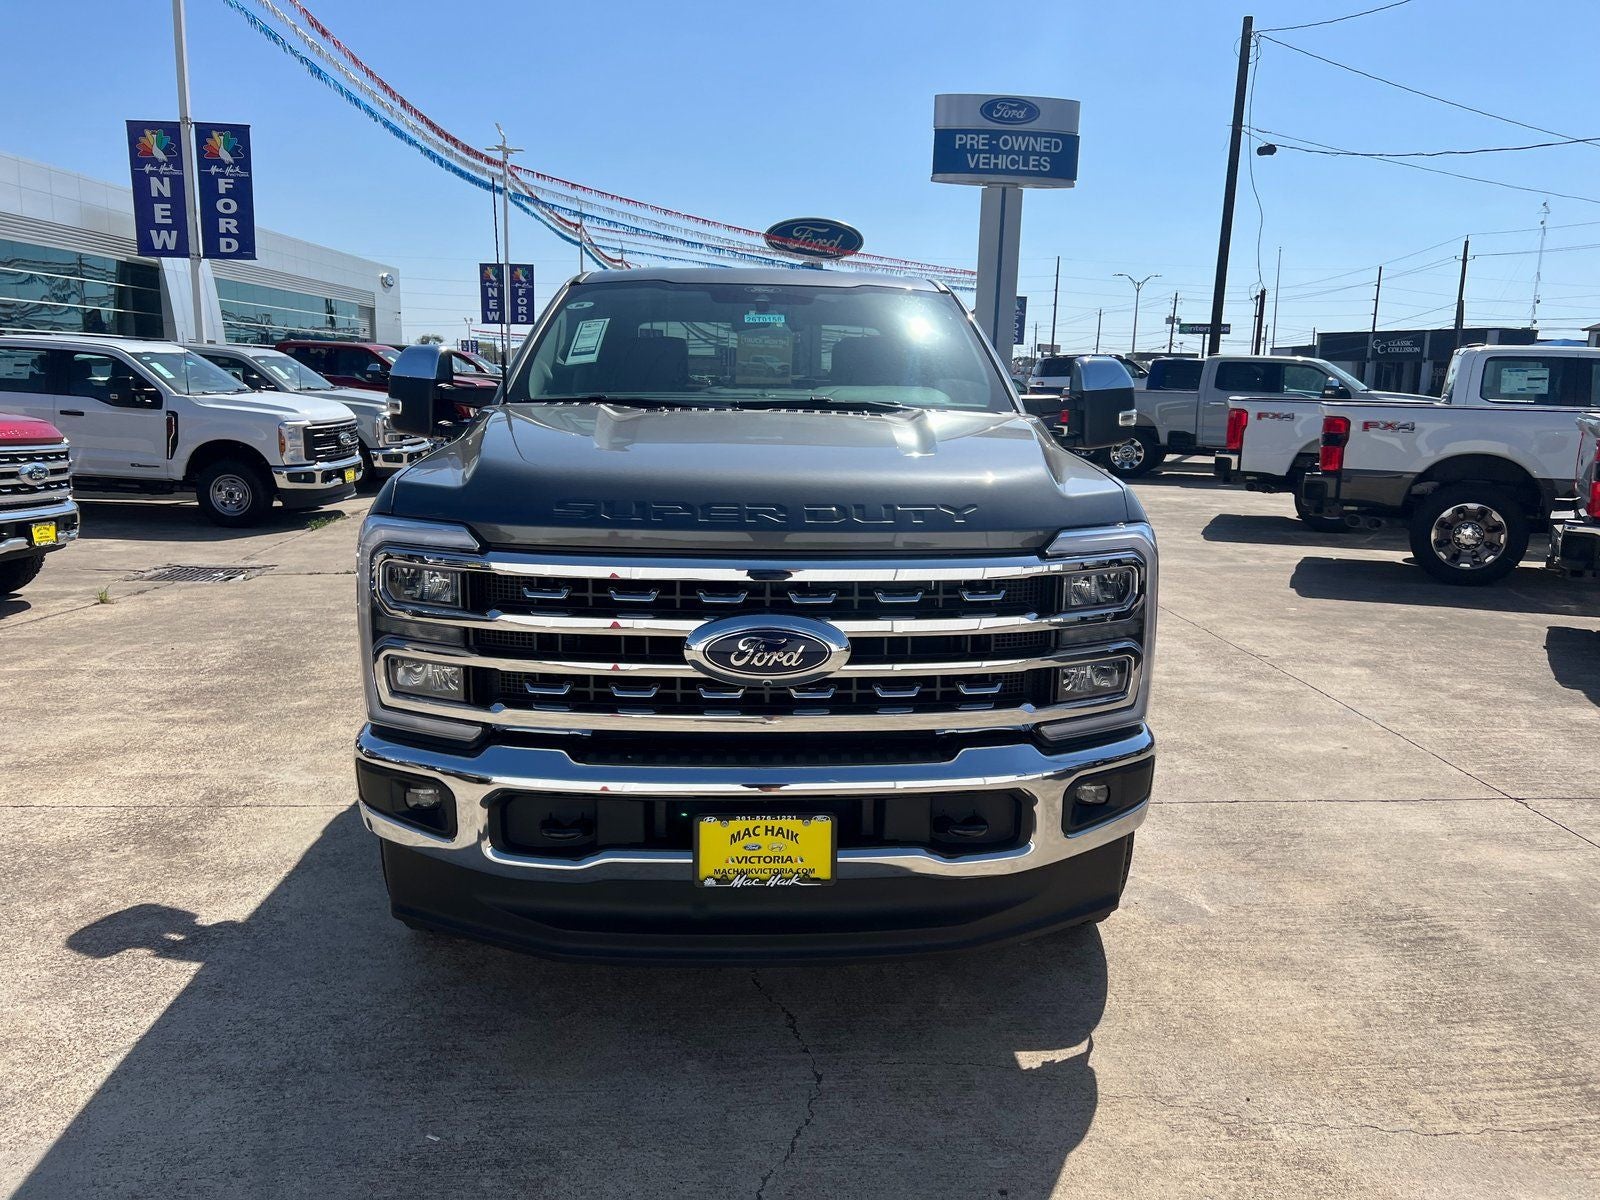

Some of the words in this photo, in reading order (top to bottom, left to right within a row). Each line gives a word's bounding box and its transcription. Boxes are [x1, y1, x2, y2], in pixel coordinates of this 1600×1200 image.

[993, 102, 1028, 119] Ford
[967, 153, 1051, 171] VEHICLES
[149, 176, 178, 251] NEW
[216, 178, 240, 253] FORD
[487, 287, 500, 321] NEW
[517, 288, 528, 322] FORD
[1256, 412, 1295, 421] FX4
[1361, 421, 1415, 433] FX4
[552, 502, 788, 523] SUPER
[803, 503, 978, 524] DUTY
[730, 636, 805, 667] Ford
[729, 826, 761, 846] MAC
[764, 825, 800, 845] HAIK
[735, 855, 794, 864] VICTORIA
[730, 874, 764, 888] Mac
[765, 874, 803, 888] Haik
